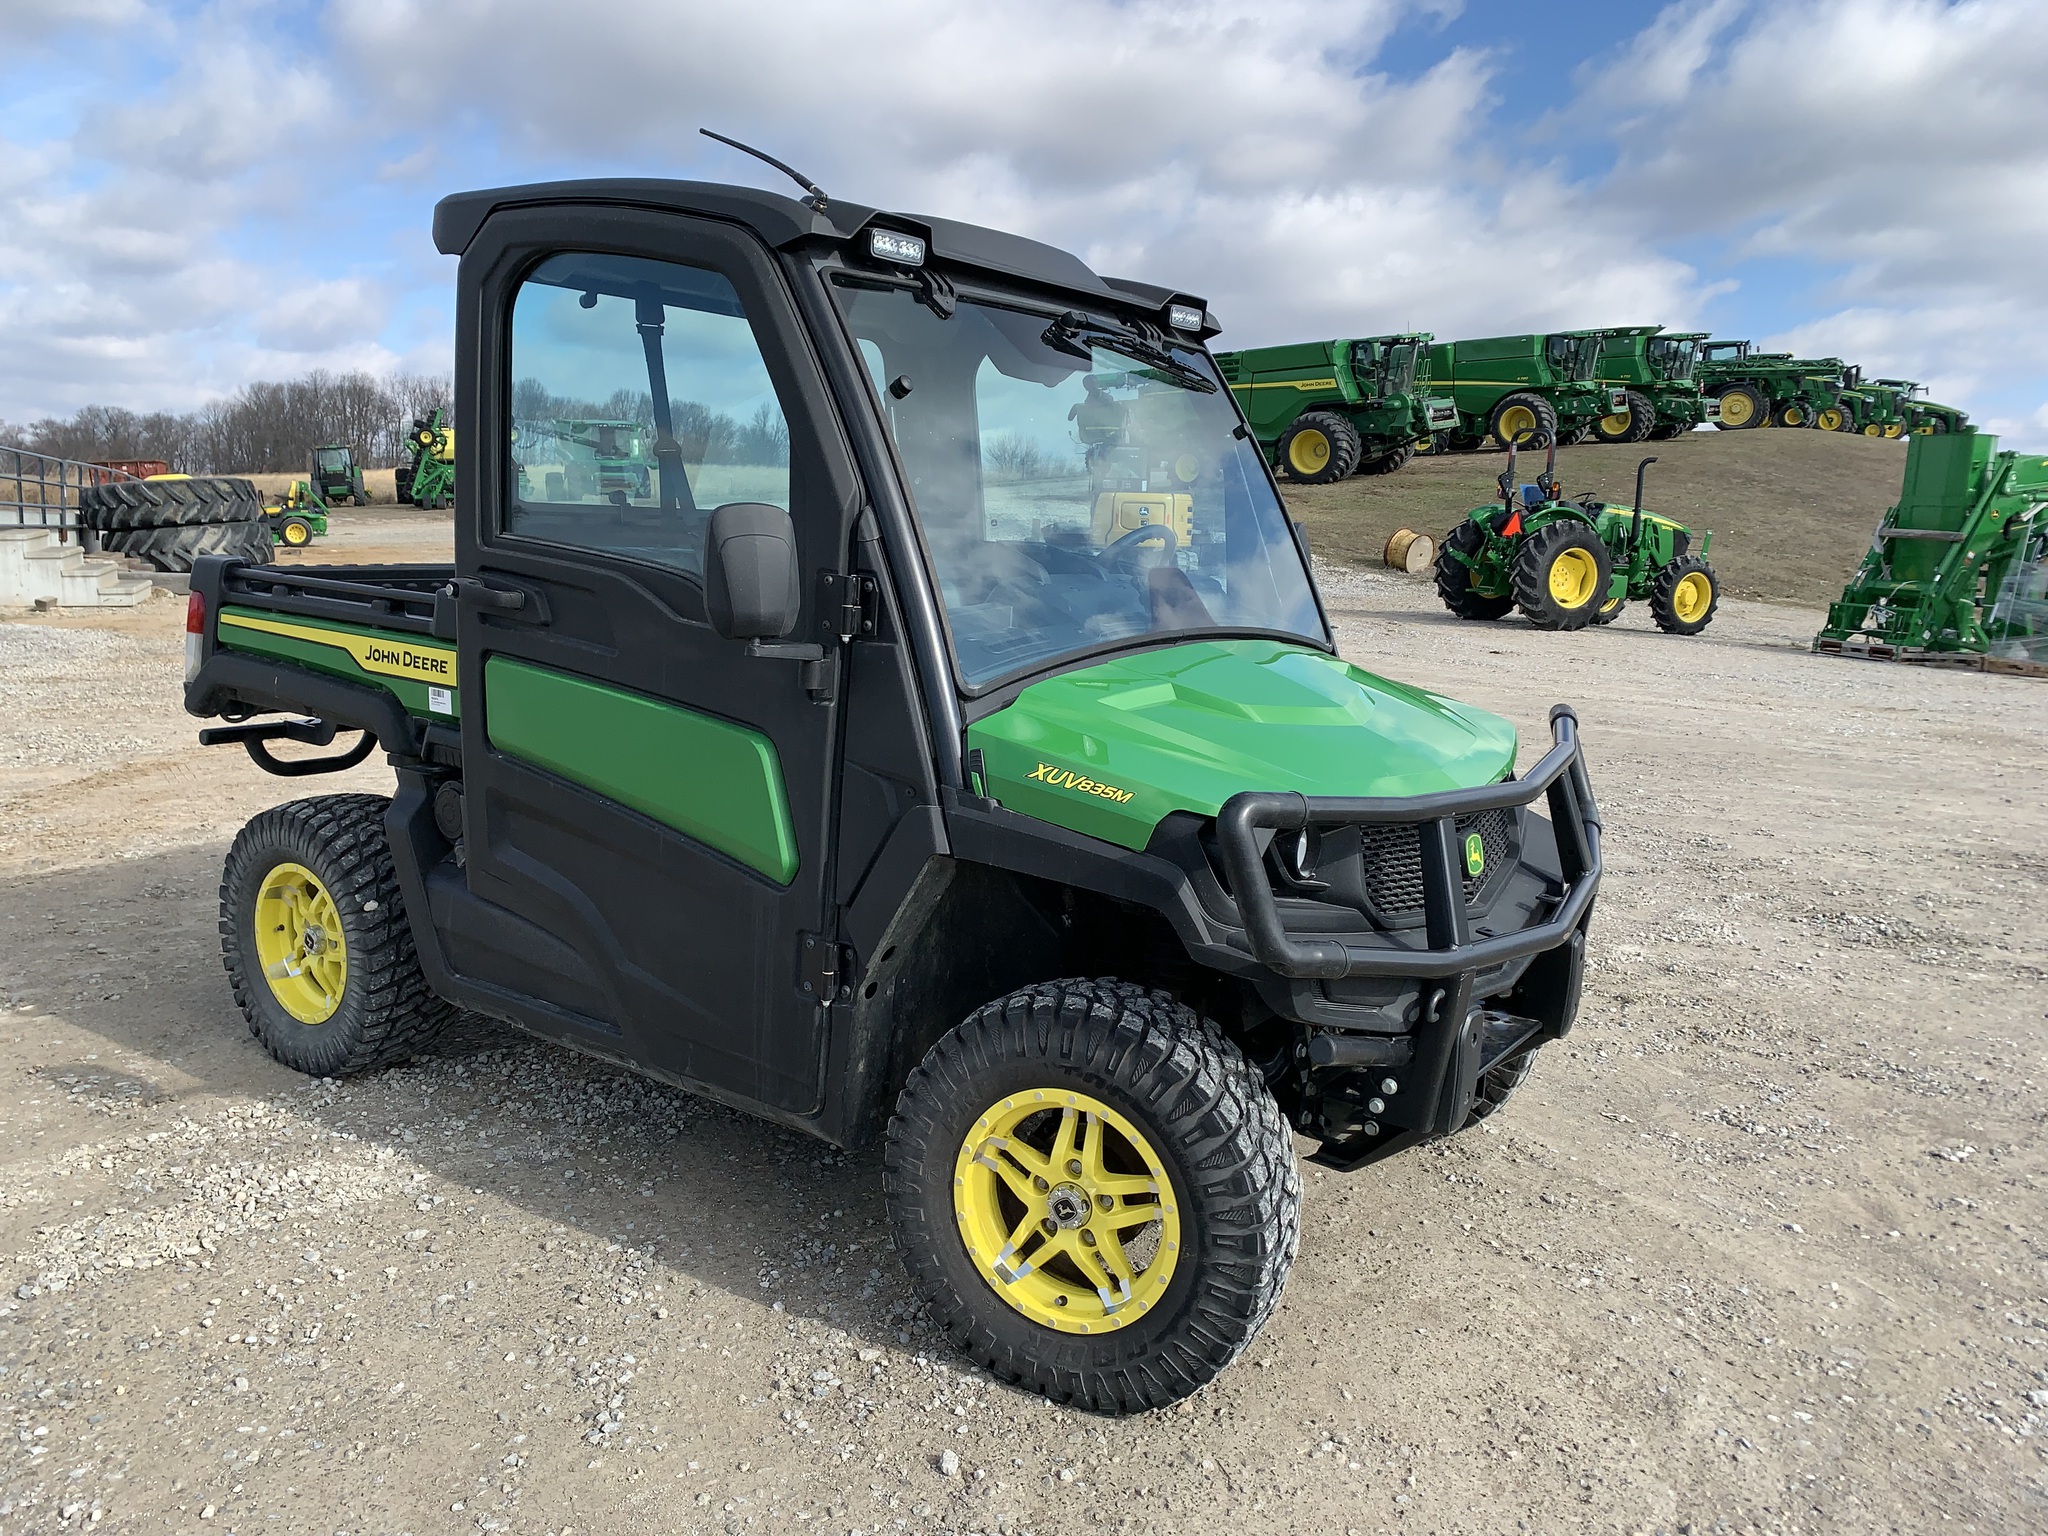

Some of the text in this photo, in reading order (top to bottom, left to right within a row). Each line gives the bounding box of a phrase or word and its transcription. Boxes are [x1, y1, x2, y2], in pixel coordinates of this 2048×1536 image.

[365, 645, 448, 674] JOHN DEERE
[1026, 762, 1137, 804] XUV835M
